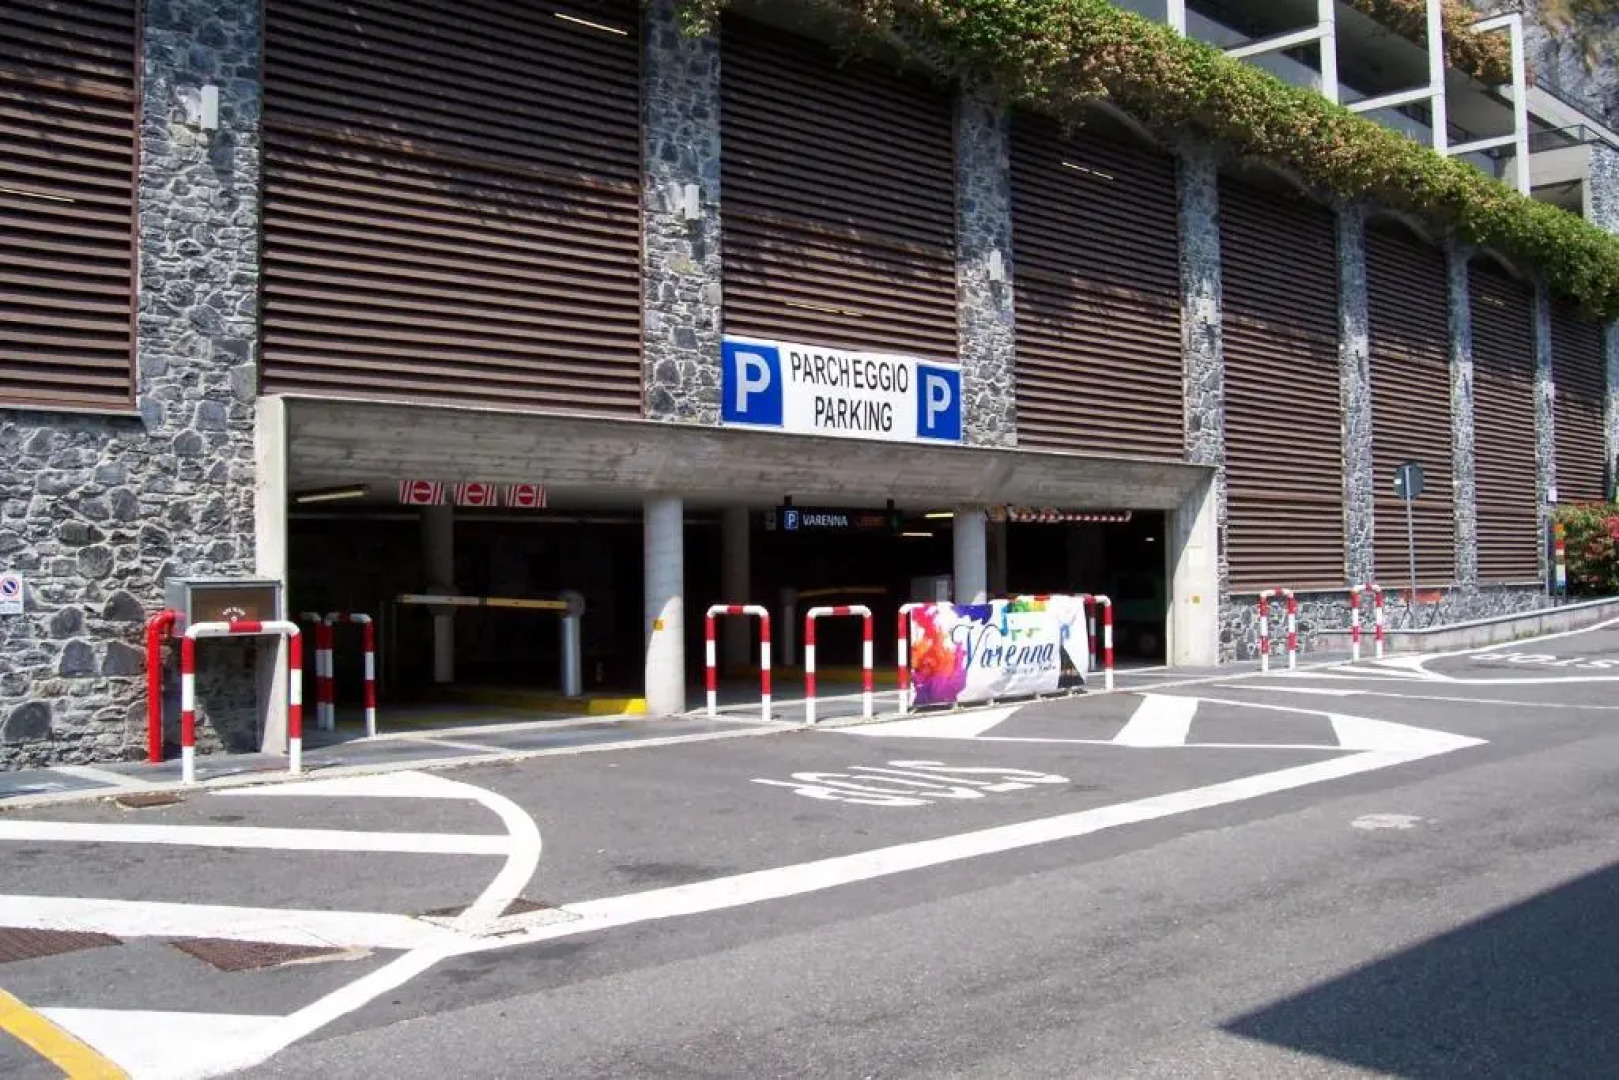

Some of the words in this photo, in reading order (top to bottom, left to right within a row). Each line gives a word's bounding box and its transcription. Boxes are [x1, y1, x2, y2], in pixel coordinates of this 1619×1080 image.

[734, 351, 771, 414] P
[790, 351, 909, 393] PARCHEGGIO
[814, 396, 893, 432] PARKING
[925, 374, 951, 429] P
[802, 513, 848, 527] VARENNA
[951, 623, 1056, 670] Varenna
